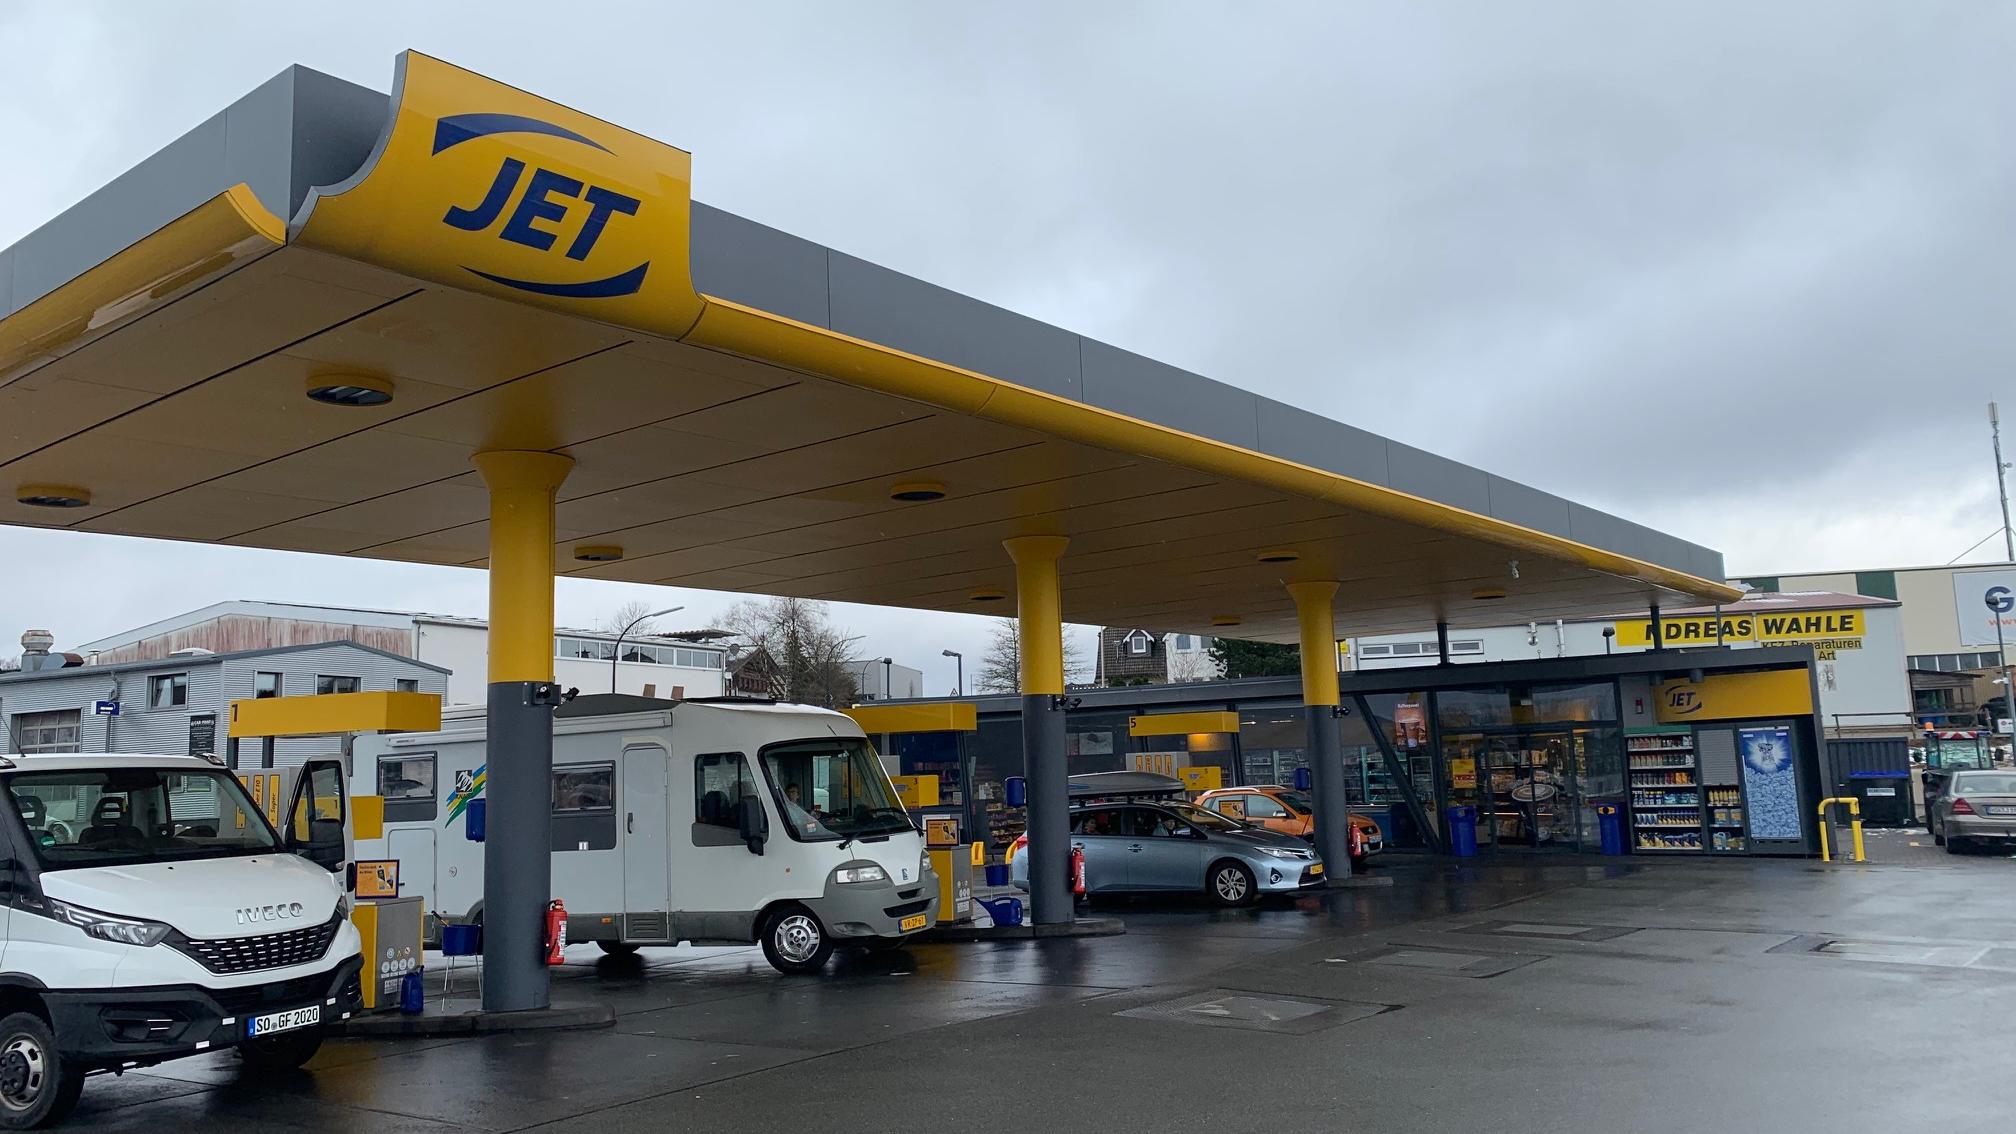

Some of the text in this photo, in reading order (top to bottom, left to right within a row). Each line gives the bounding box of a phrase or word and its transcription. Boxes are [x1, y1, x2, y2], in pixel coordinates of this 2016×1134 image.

[443, 157, 641, 261] JET
[1763, 615, 1854, 635] WAHLE
[1818, 651, 1836, 661] Art
[1669, 692, 1696, 706] JET
[231, 704, 238, 722] 1
[1130, 718, 1137, 728] 5
[334, 800, 338, 809] 1
[236, 902, 303, 925] IVECO
[256, 1007, 318, 1033] SO GF 2020
